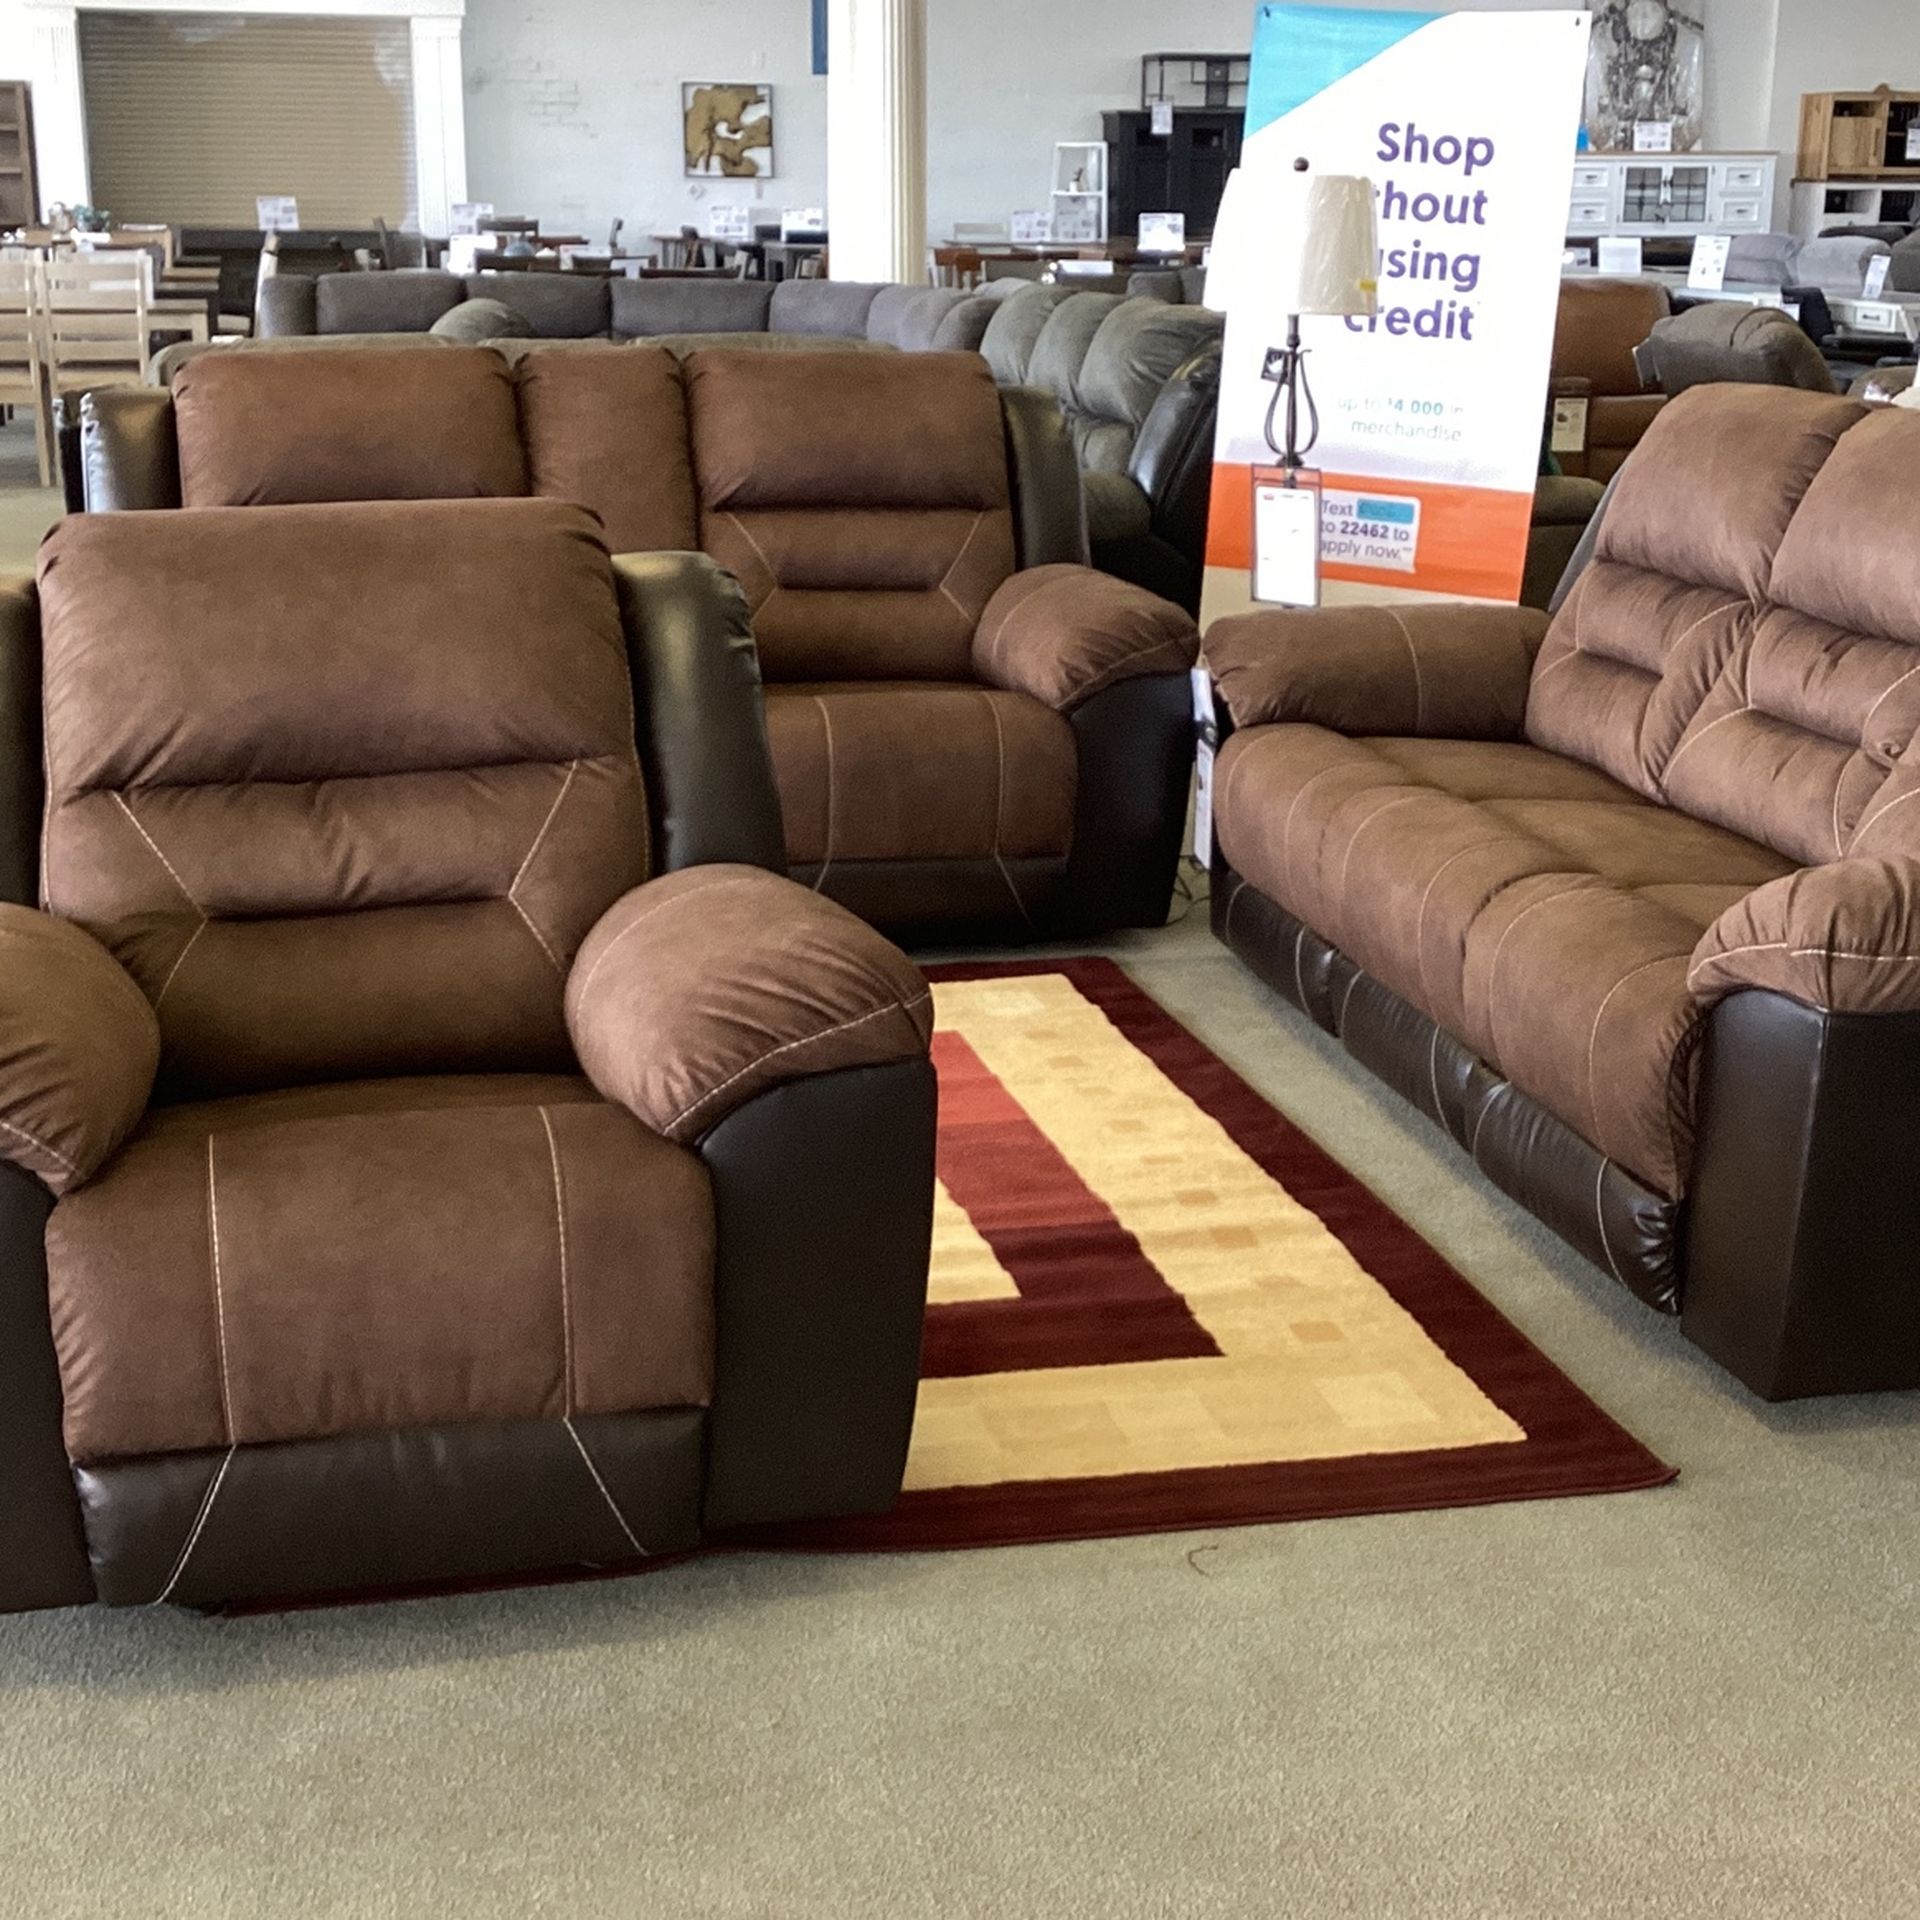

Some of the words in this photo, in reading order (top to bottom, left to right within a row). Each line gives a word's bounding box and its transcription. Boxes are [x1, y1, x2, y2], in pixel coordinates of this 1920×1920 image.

[1376, 122, 1494, 176] Shop
[1376, 180, 1488, 225] hout
[1378, 239, 1480, 292] sing
[1351, 420, 1462, 442] merchandise
[1322, 500, 1353, 517] Text
[1340, 520, 1389, 540] 22462
[1393, 527, 1410, 542] to
